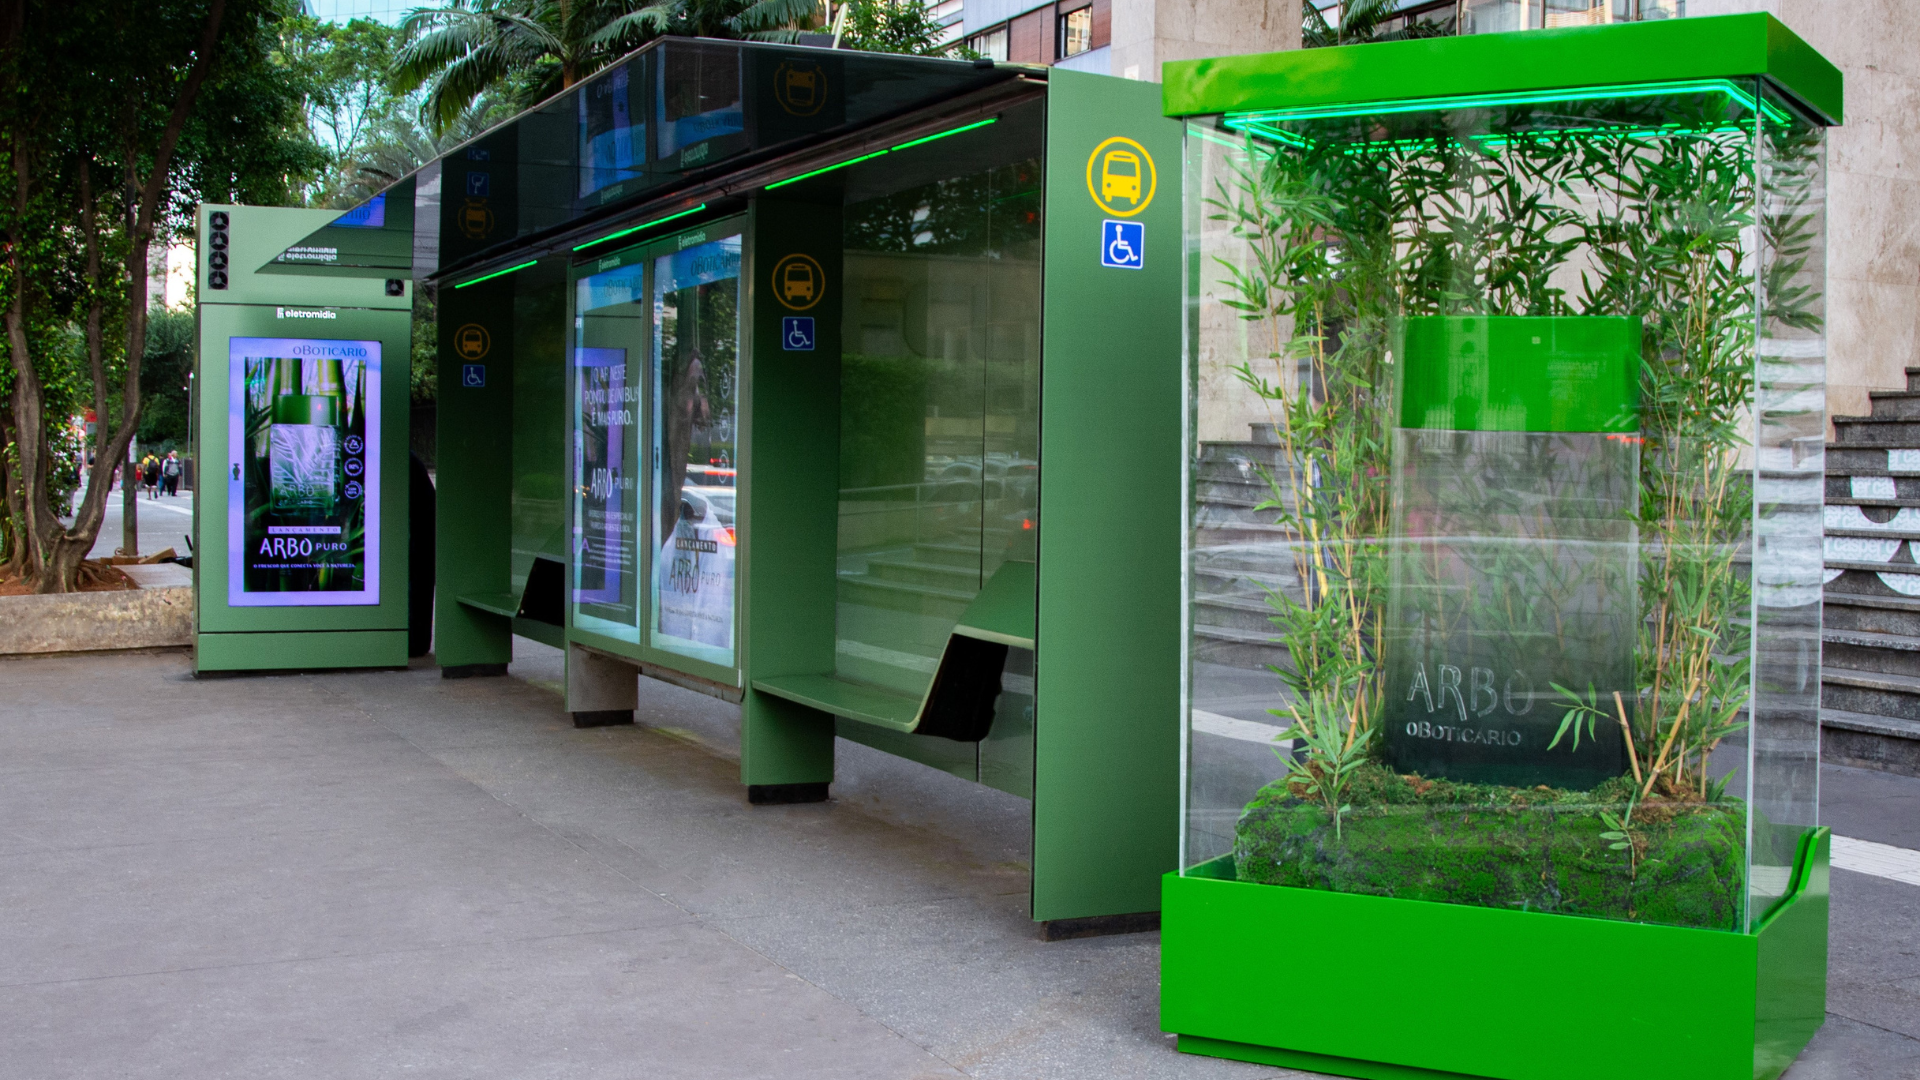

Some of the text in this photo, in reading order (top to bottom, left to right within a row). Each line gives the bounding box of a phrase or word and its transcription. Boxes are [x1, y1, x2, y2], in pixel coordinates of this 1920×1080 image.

[285, 309, 337, 320] eletromidia
[590, 467, 613, 502] ARBO
[272, 526, 338, 534] LANÇAMENTO
[260, 537, 348, 560] ARBO PURO
[676, 540, 717, 552] LANÇAMENTO
[668, 557, 721, 597] ARBO PURO
[1406, 661, 1535, 722] ARBO
